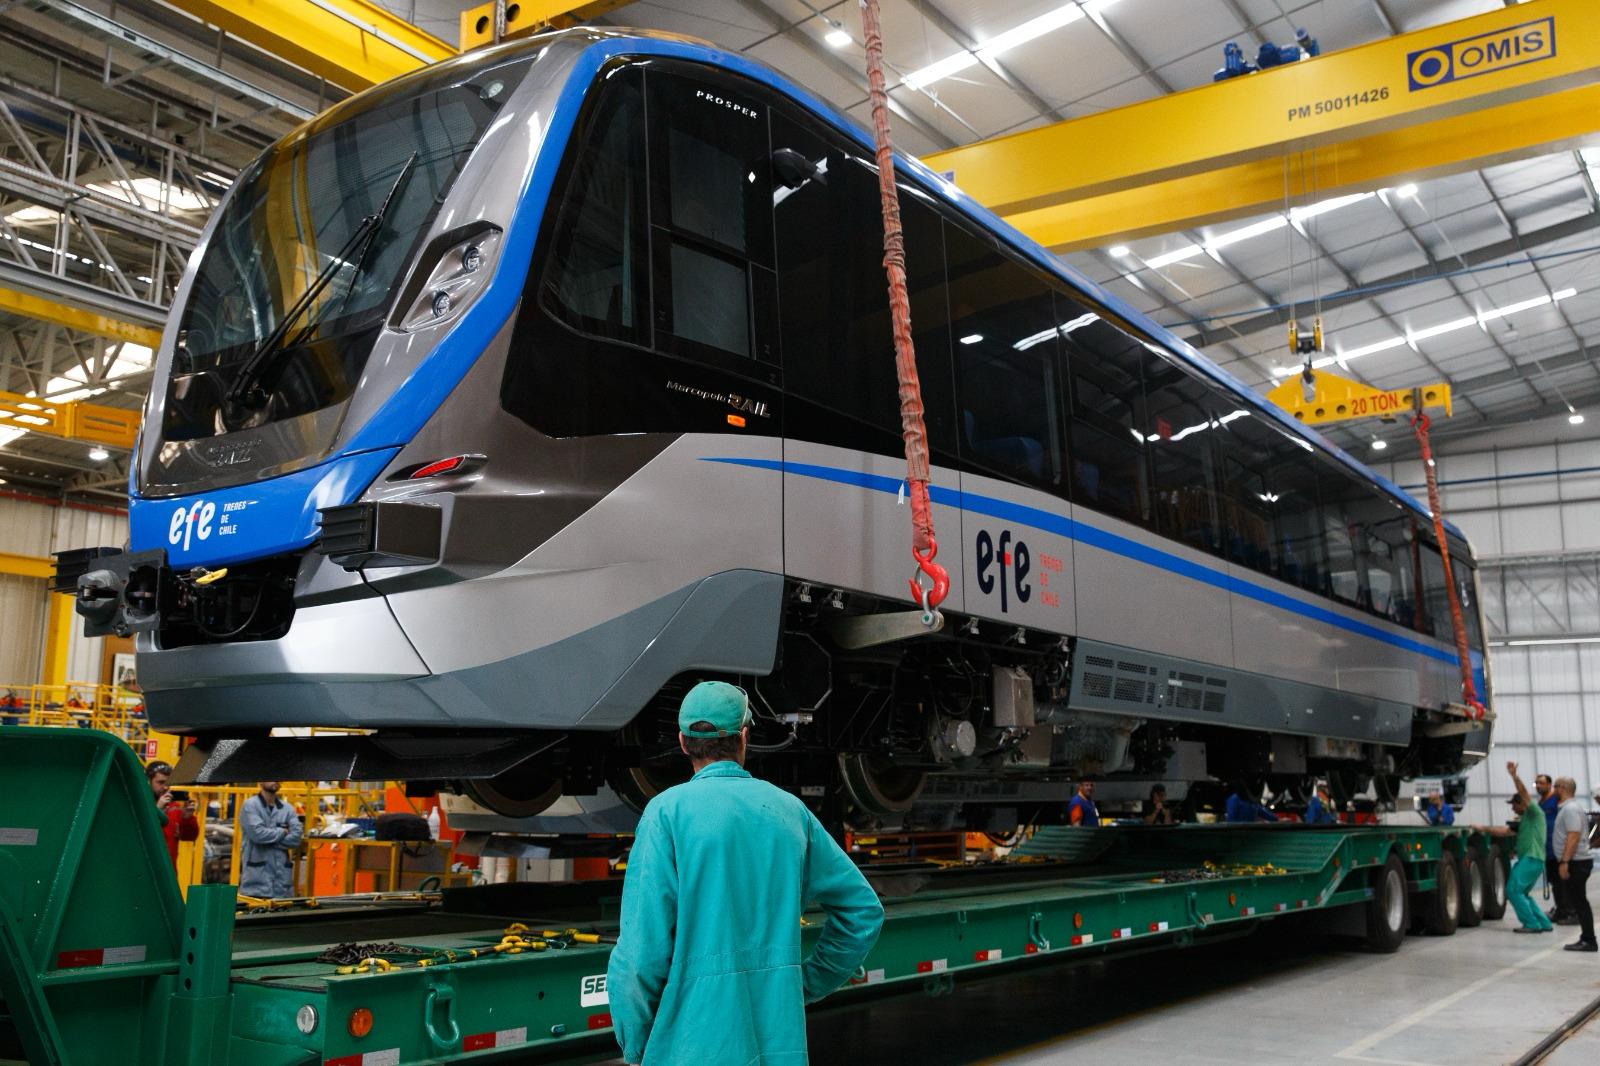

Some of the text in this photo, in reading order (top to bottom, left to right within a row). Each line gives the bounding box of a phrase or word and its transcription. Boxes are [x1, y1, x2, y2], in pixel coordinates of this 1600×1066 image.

[1460, 30, 1544, 68] OMIS
[696, 90, 757, 119] PROSPER
[1288, 86, 1390, 121] PM 50011426
[666, 380, 726, 402] Marcopolo
[1351, 392, 1399, 416] 20 TON
[168, 500, 216, 552] efe
[219, 524, 238, 536] CHILE
[220, 514, 229, 524] DE
[976, 529, 1031, 614] efe
[583, 976, 608, 995] SE
